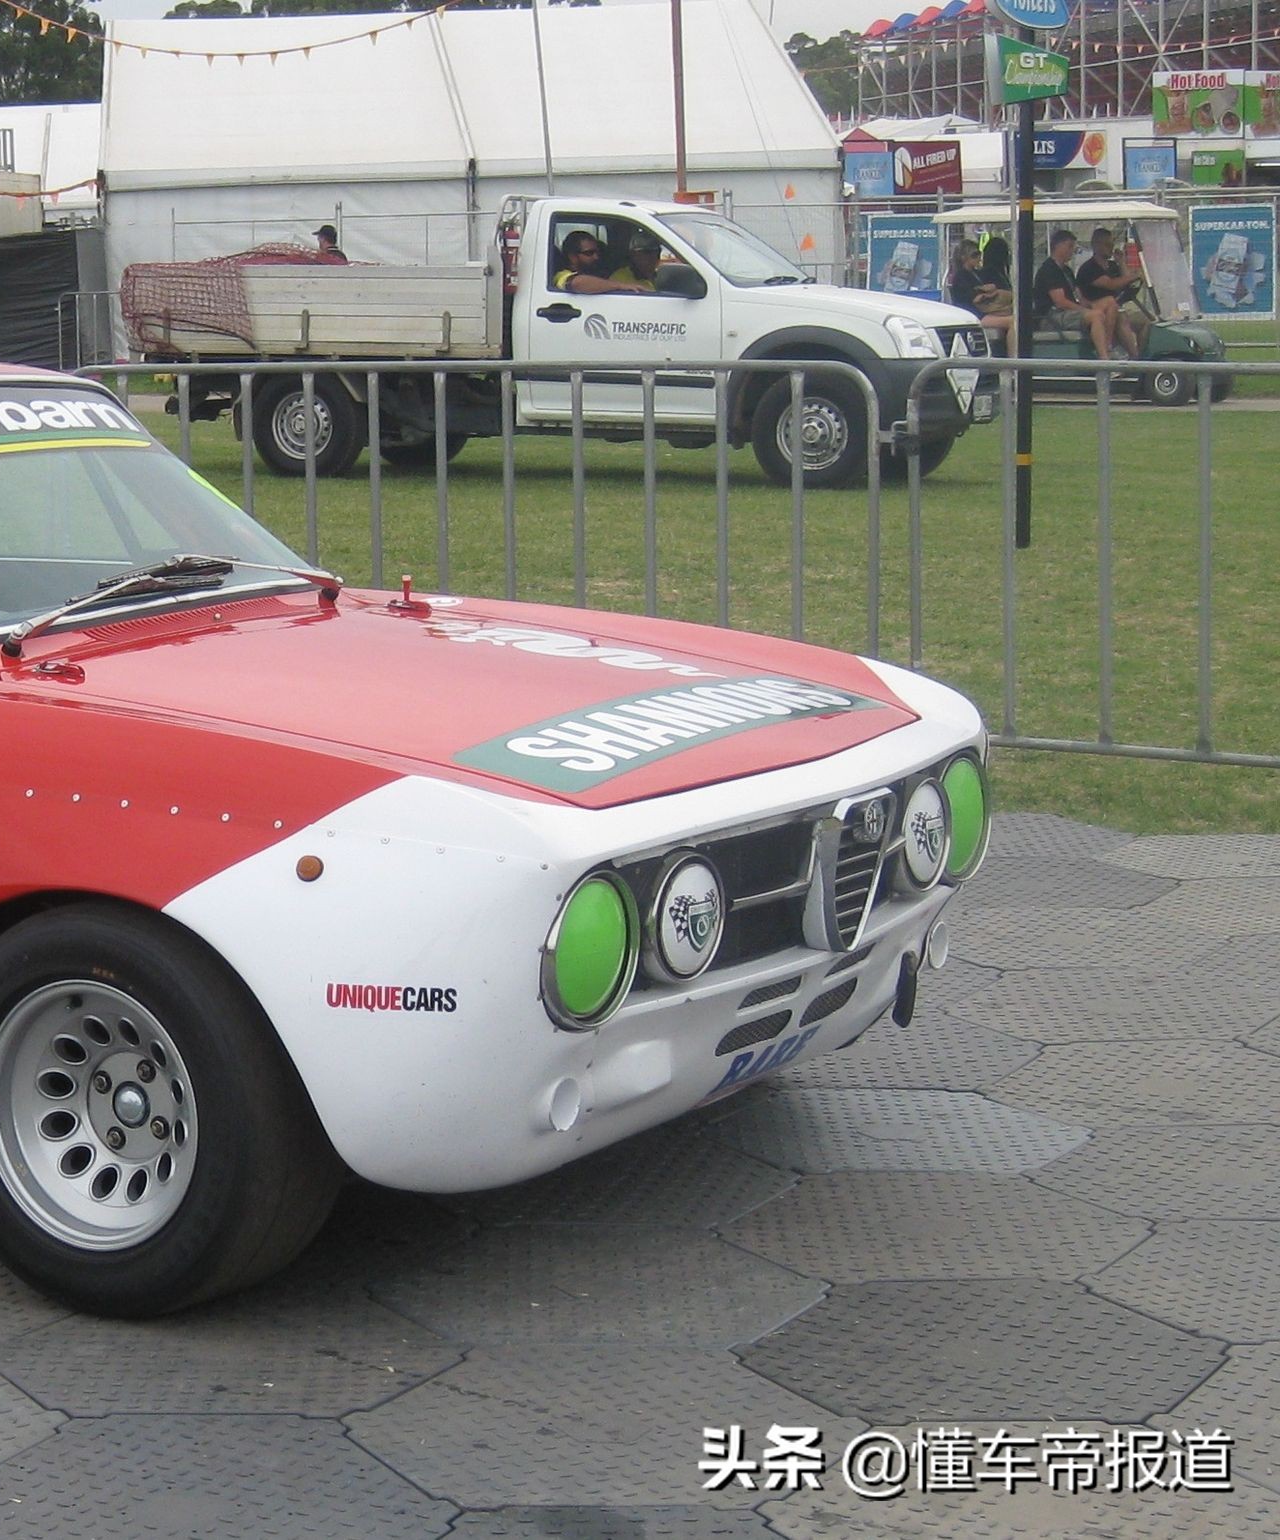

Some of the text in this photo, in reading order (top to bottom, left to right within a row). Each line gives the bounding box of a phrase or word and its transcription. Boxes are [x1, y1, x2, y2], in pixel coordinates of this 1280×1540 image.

[1020, 52, 1048, 69] GT
[1170, 72, 1225, 90] Hot Food
[913, 155, 926, 169] ALL
[612, 322, 686, 335] TRANSPACIFIC
[505, 679, 853, 772] SHANNONS
